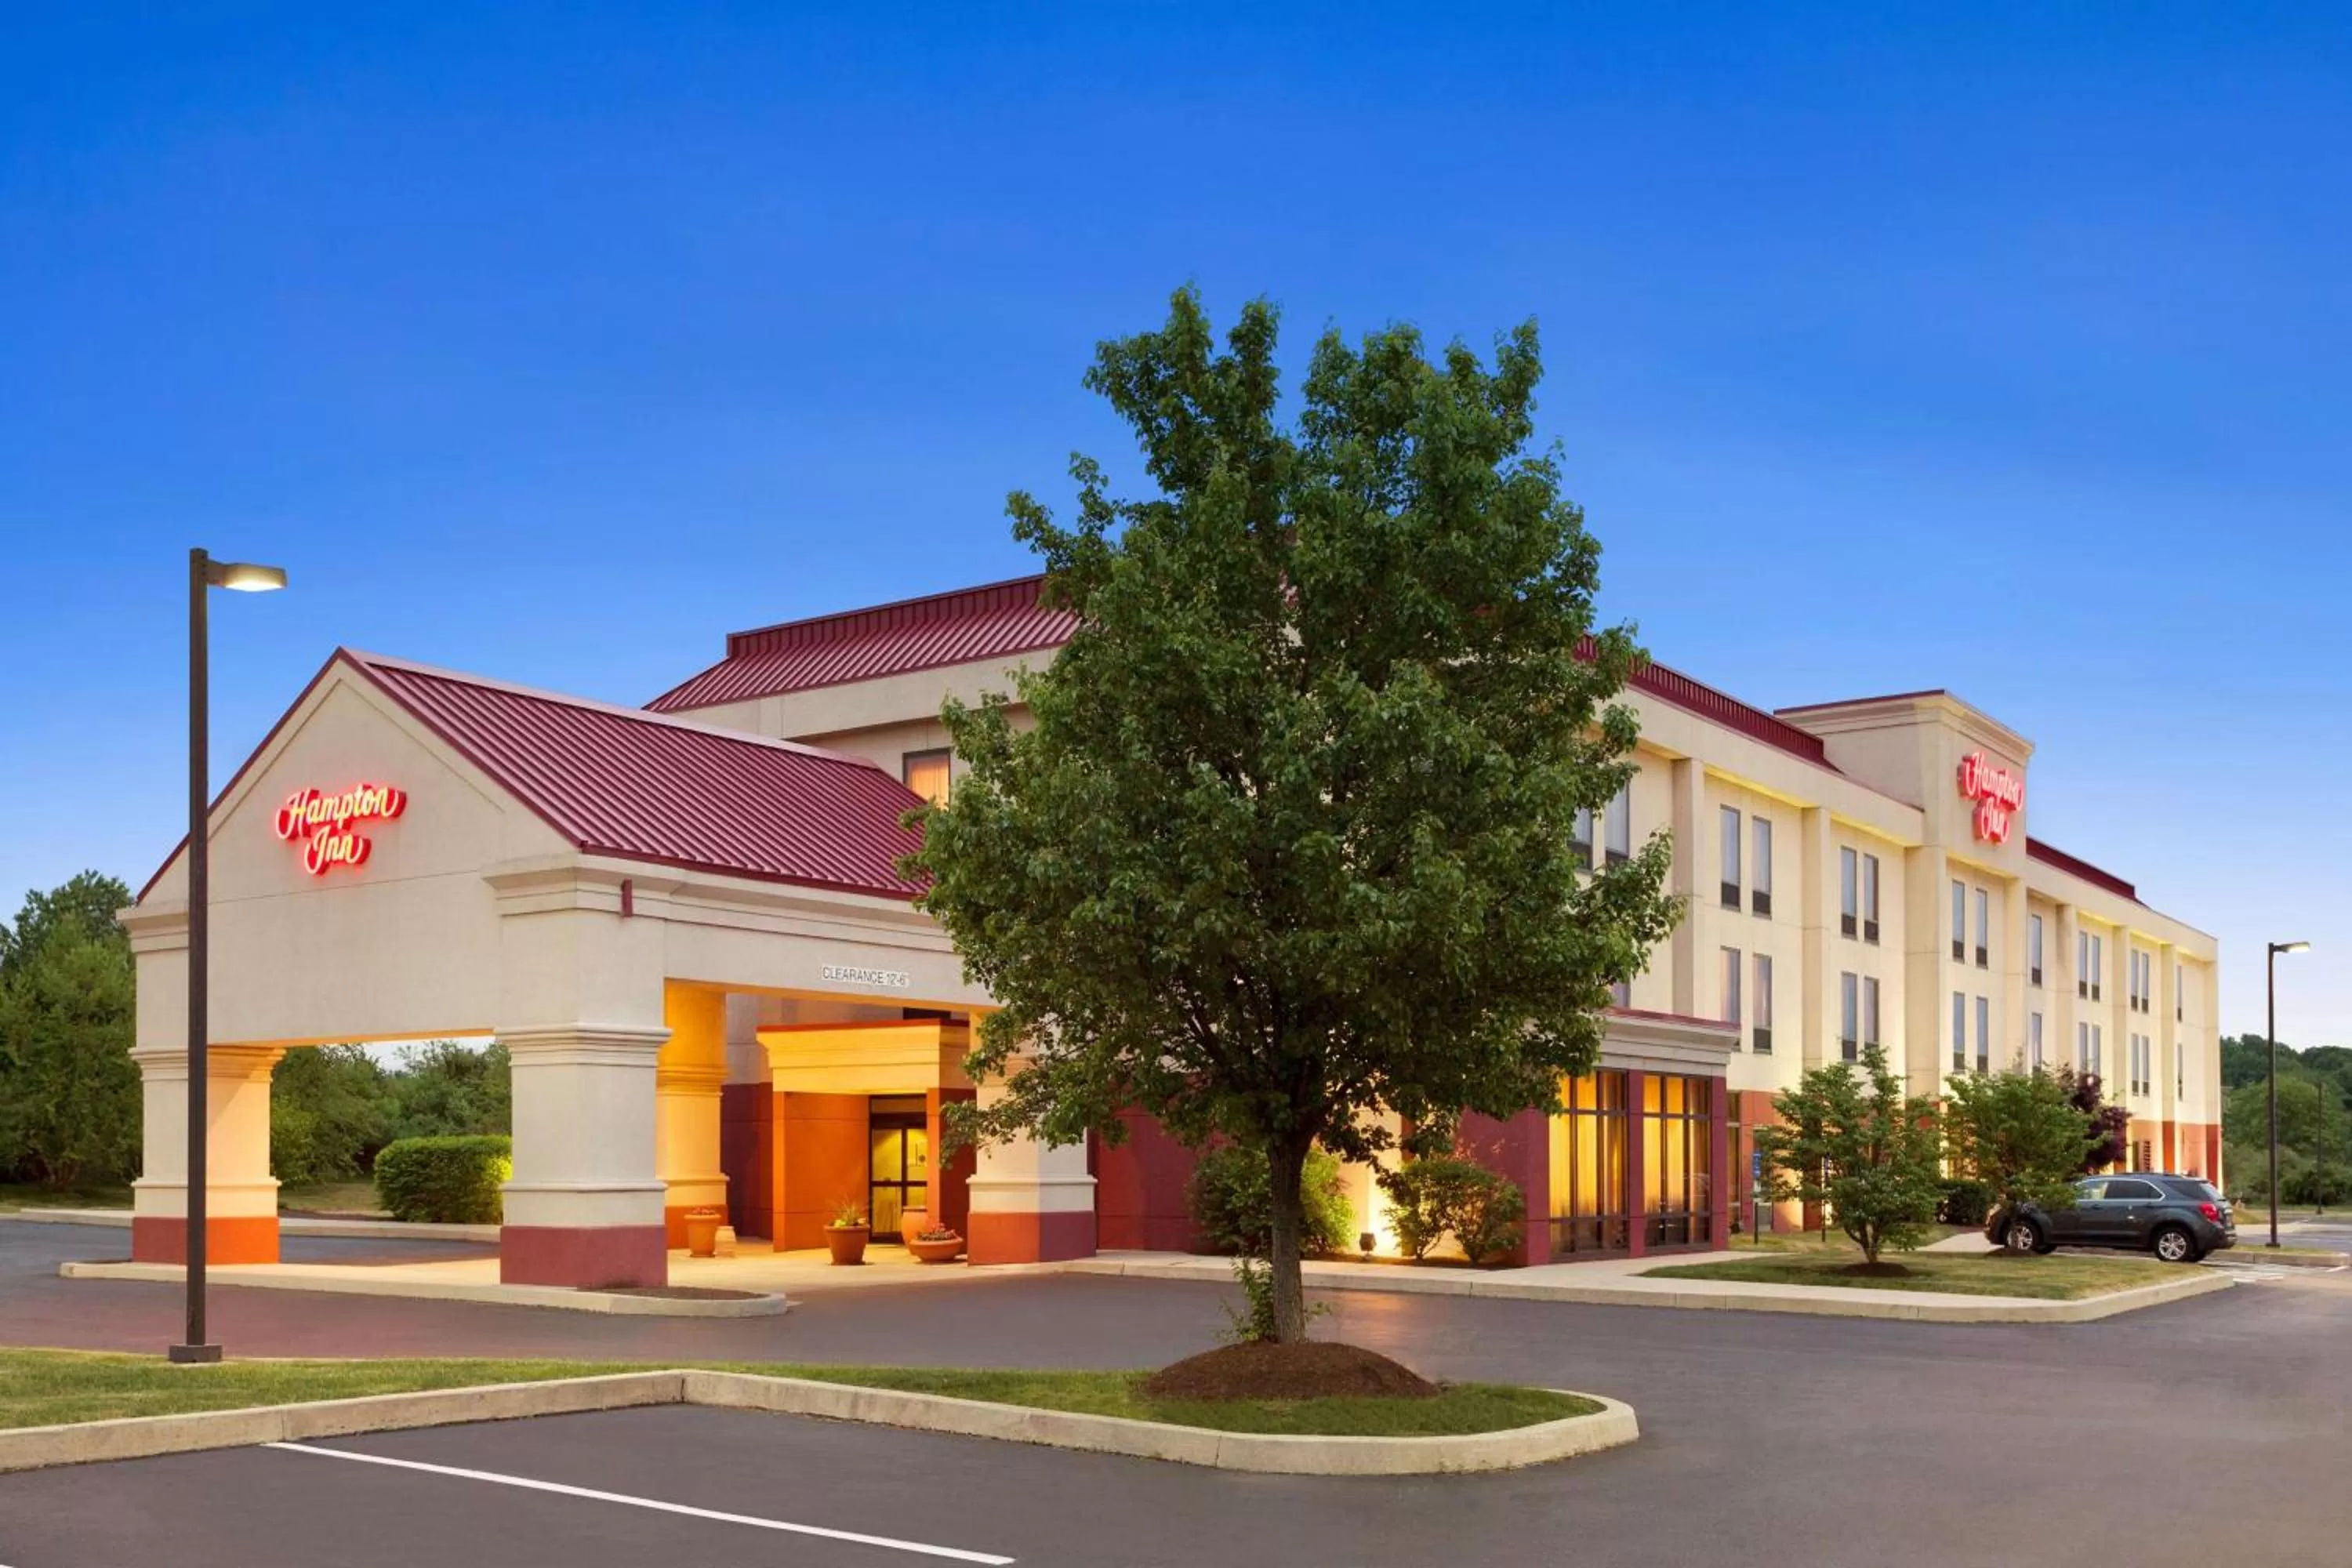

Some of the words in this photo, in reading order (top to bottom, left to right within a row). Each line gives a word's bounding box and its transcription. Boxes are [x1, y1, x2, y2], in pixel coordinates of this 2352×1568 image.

[1958, 752, 2024, 811] Hampton
[275, 784, 407, 840] Hampton
[1973, 796, 2010, 844] Inn
[304, 826, 372, 876] Inn
[822, 966, 884, 984] CLEARANCE
